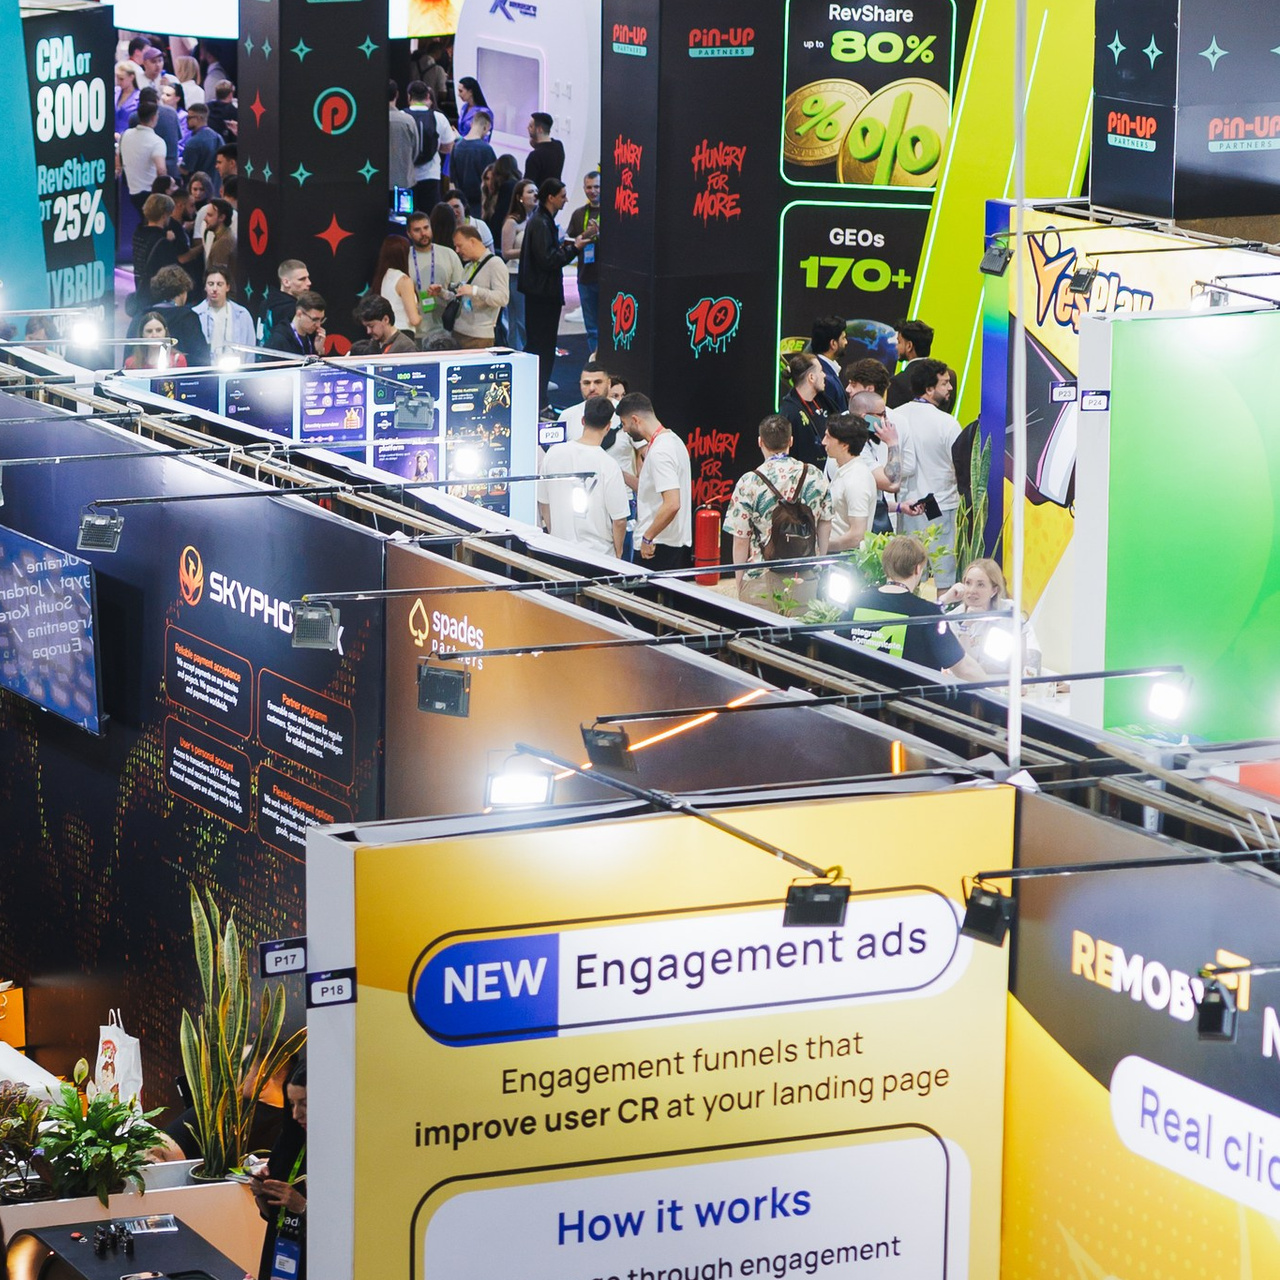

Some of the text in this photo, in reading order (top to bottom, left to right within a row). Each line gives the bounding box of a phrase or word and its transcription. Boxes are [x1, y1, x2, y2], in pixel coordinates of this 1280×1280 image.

[828, 3, 914, 23] RevShare
[36, 35, 75, 82] CPA
[697, 48, 747, 57] PARTNERS
[803, 30, 937, 64] up to 80%
[36, 79, 106, 143] 8000
[692, 138, 747, 174] HUNGRY
[1114, 136, 1149, 149] PARTNERS
[1219, 140, 1273, 151] PARTNERS
[37, 157, 106, 196] RevShare
[708, 171, 729, 195] FOR
[52, 188, 106, 244] 25%
[693, 192, 742, 220] MORE
[829, 228, 885, 248] GEOs
[799, 255, 912, 293] 170+
[1057, 390, 1072, 398] P23
[1087, 399, 1103, 407] P24
[544, 431, 560, 440] P20
[432, 609, 485, 652] spades
[274, 954, 297, 967] P17
[442, 921, 929, 1006] NEW Engagement ads
[321, 985, 344, 997] P18
[502, 1030, 865, 1099] Engagement funnels that
[414, 1063, 951, 1150] improve user CR at your landing page
[1140, 1085, 1212, 1160] Real
[556, 1185, 812, 1246] How it works
[739, 1235, 902, 1278] engagement
